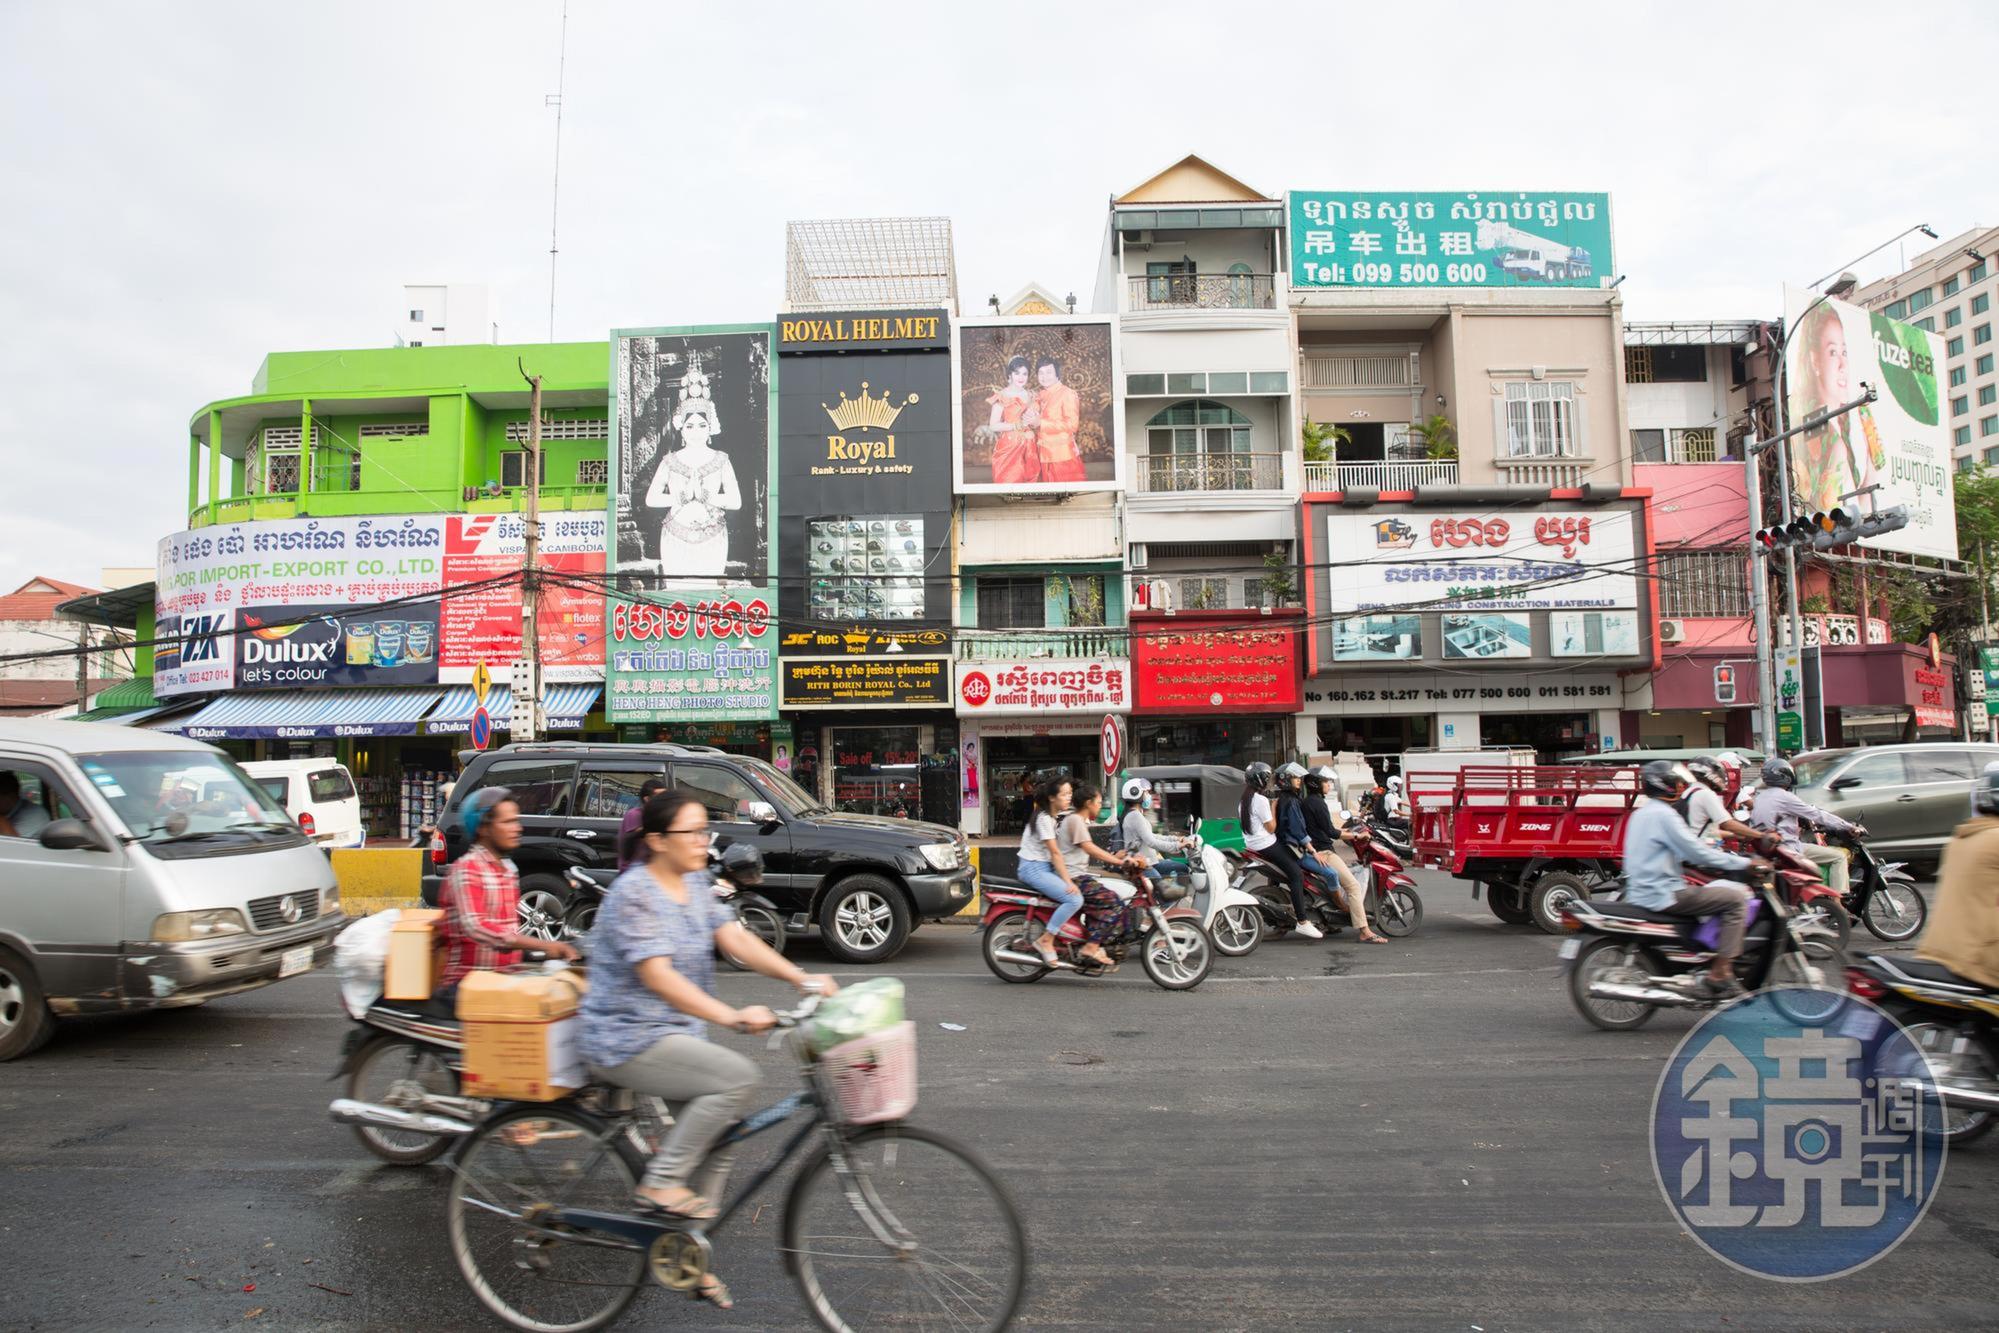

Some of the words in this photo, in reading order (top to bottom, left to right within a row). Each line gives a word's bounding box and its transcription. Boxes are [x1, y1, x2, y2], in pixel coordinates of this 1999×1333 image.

[1304, 230, 1475, 256] 吊车出租
[1303, 263, 1346, 282] Tel:
[1352, 263, 1393, 283] 099
[1400, 263, 1439, 282] 500
[1446, 263, 1486, 282] 600
[782, 319, 849, 343] ROYAL
[852, 317, 940, 340] HELMET
[827, 434, 896, 465] Royal
[883, 464, 913, 474] safety
[1430, 516, 1511, 548] ហេង
[546, 544, 604, 553] CAMBODIA
[199, 560, 349, 584] IMPORT-EXPORT
[1467, 600, 1550, 609] CONSTRUCTION
[1554, 598, 1616, 608] MATERIALS
[817, 634, 839, 645] ROC
[243, 638, 328, 664] Dulux
[847, 645, 866, 655] Royal
[243, 669, 272, 682] let's
[275, 668, 328, 681] colour
[806, 681, 830, 690] RITH
[832, 681, 862, 689] BORIN
[864, 680, 896, 689] ROYAL
[1305, 691, 1322, 703] No
[1380, 689, 1420, 701] St.217
[1425, 688, 1448, 700] Tel:
[1452, 687, 1476, 699] 077
[1480, 687, 1503, 699] 500
[1507, 686, 1531, 699] 600
[1538, 686, 1559, 698] 011
[1563, 686, 1586, 697] 581
[1589, 685, 1612, 697] 581
[612, 697, 646, 711] HENG
[647, 697, 682, 710] HENG
[682, 696, 725, 709] PHOTO
[725, 695, 770, 708] STUDIO
[439, 722, 470, 732] Dulux
[494, 719, 512, 730] Dul
[549, 718, 581, 729] Dulux
[196, 728, 227, 737] Dulux
[286, 727, 316, 738] Dulux
[344, 725, 374, 736] Dulux
[840, 751, 858, 765] Sale
[860, 751, 873, 765] off
[1519, 823, 1552, 831] ZONG
[1579, 824, 1611, 832] SHEN
